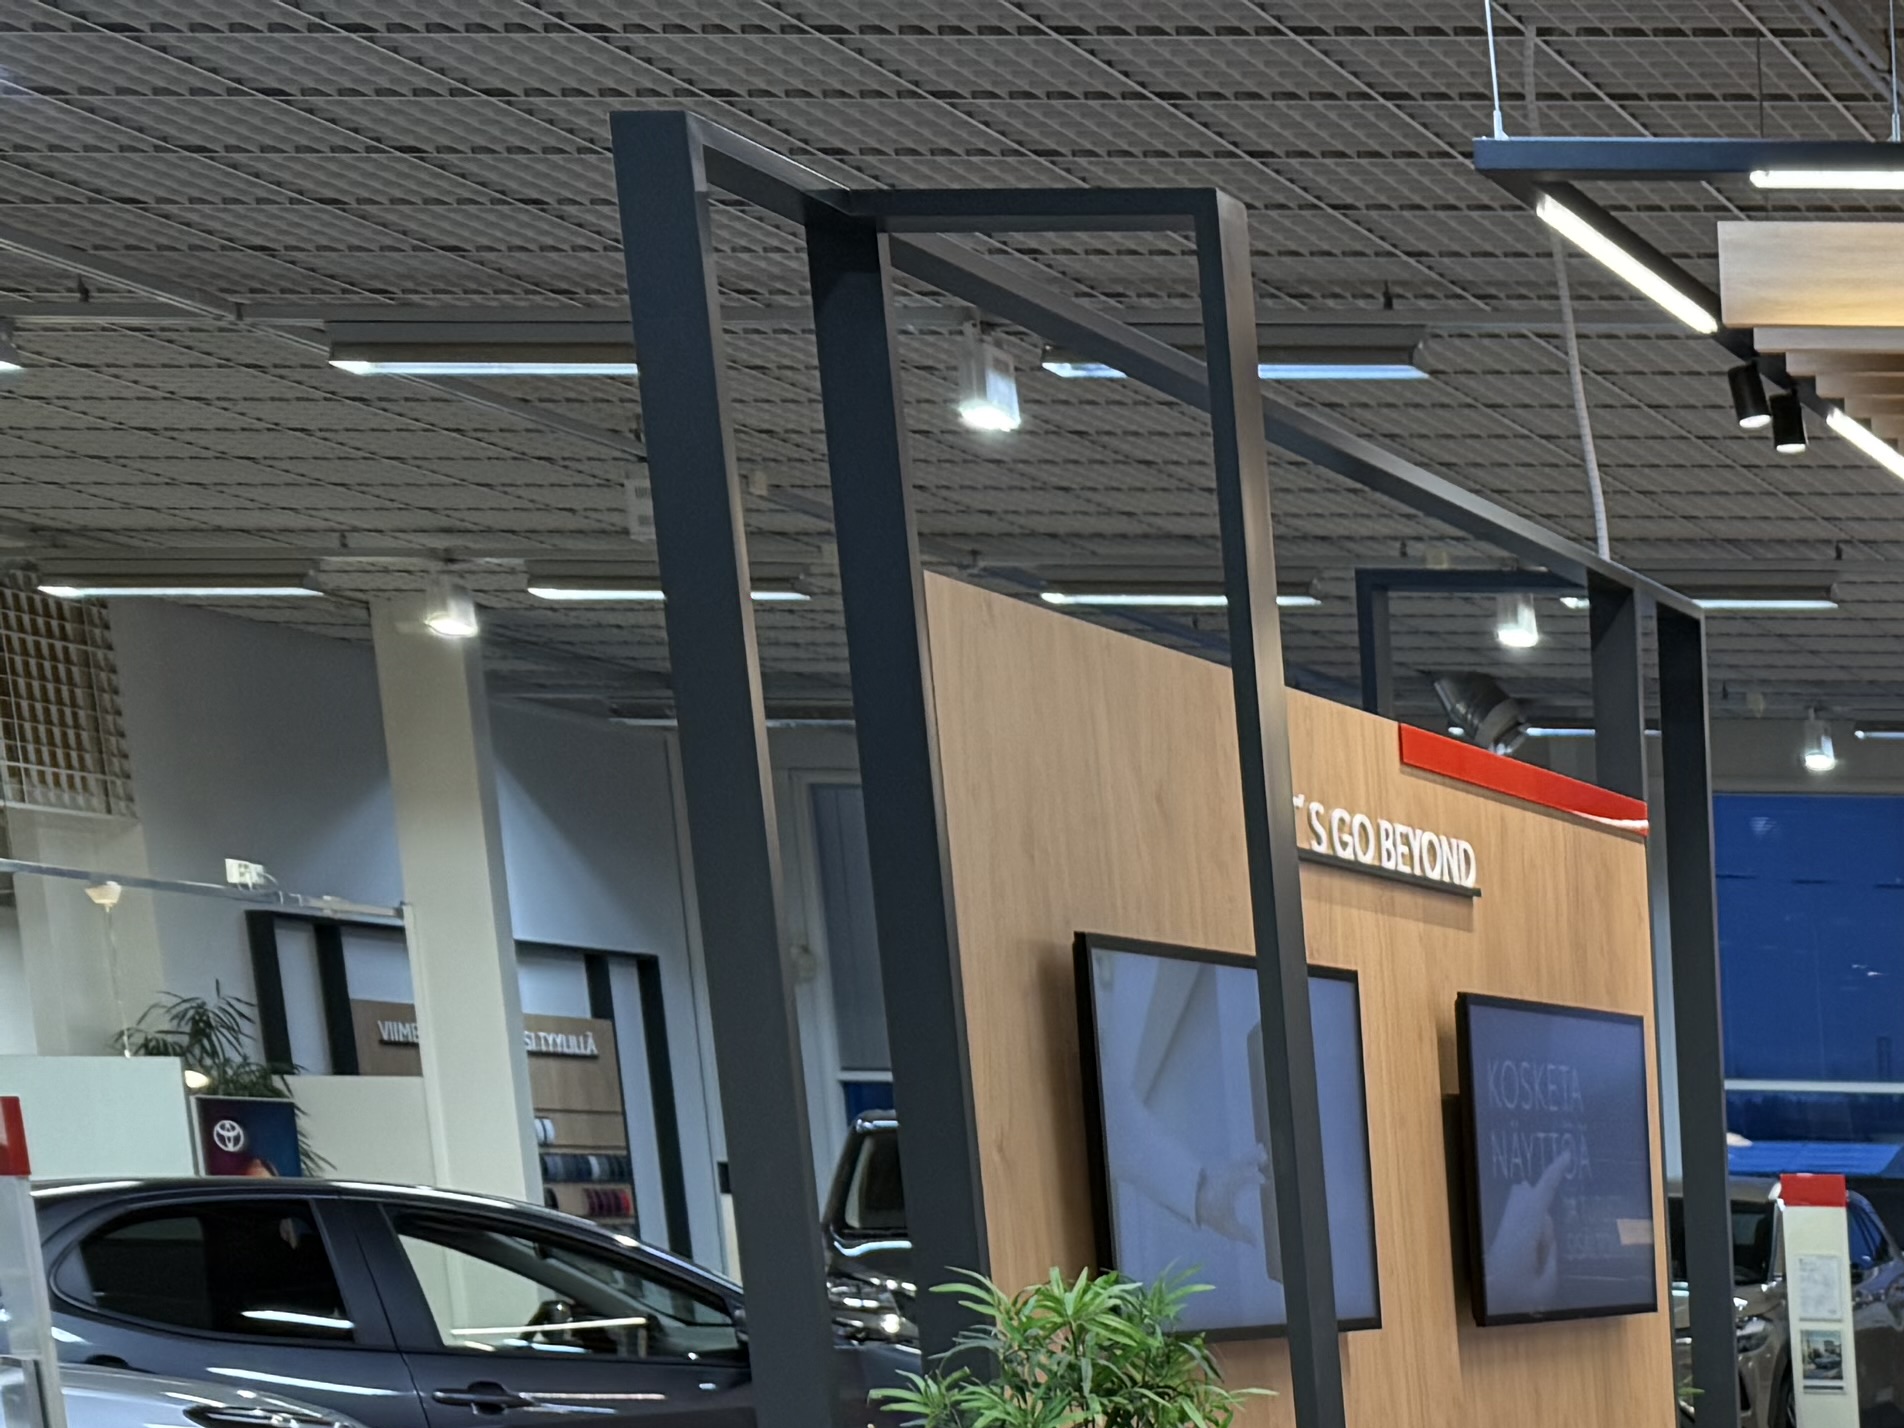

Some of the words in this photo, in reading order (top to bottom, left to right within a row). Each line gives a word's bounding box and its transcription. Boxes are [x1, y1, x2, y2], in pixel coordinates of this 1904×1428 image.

[1330, 808, 1375, 865] GO
[1377, 818, 1477, 889] BEYOND
[537, 1030, 599, 1056] TYYLILLÄ
[1487, 1059, 1585, 1113] KOSKETA
[1490, 1119, 1594, 1181] NÄYTTÖÄ
